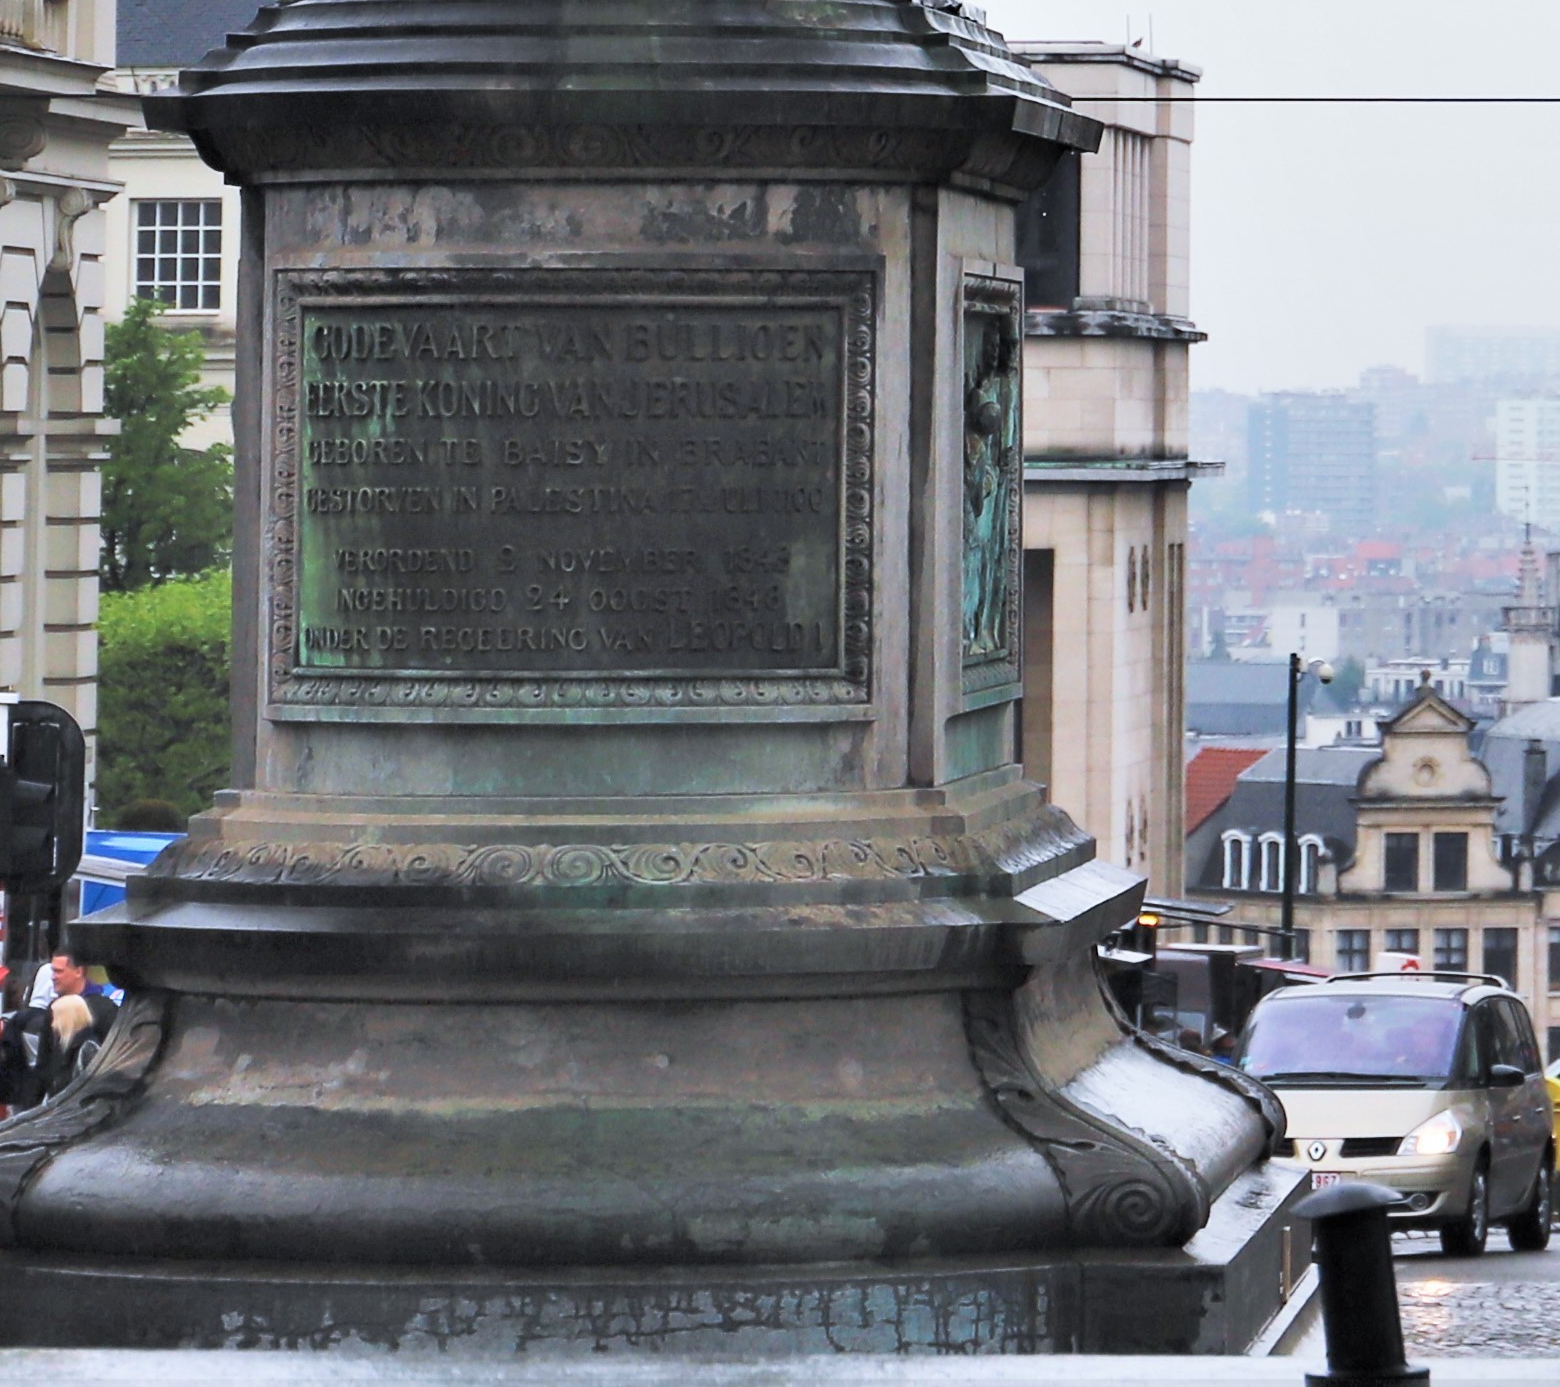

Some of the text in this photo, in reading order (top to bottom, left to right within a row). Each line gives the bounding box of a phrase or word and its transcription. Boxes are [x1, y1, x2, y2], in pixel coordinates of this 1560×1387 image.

[314, 322, 516, 361] GODEVAART
[540, 322, 612, 362] VAN
[307, 380, 828, 419] EERSTE KONING VAN JERUSALEM
[309, 438, 425, 465] GEBOREN
[440, 438, 482, 465] TE
[503, 438, 609, 466] BAISY
[307, 486, 440, 514] GESTORVEN
[453, 486, 478, 513] IN
[334, 548, 475, 573] VERORDEND
[538, 547, 696, 574] NOVEMBER
[525, 583, 571, 611] 24
[305, 626, 370, 651] ONDER
[377, 626, 409, 651] DE
[598, 626, 654, 652] VAN
